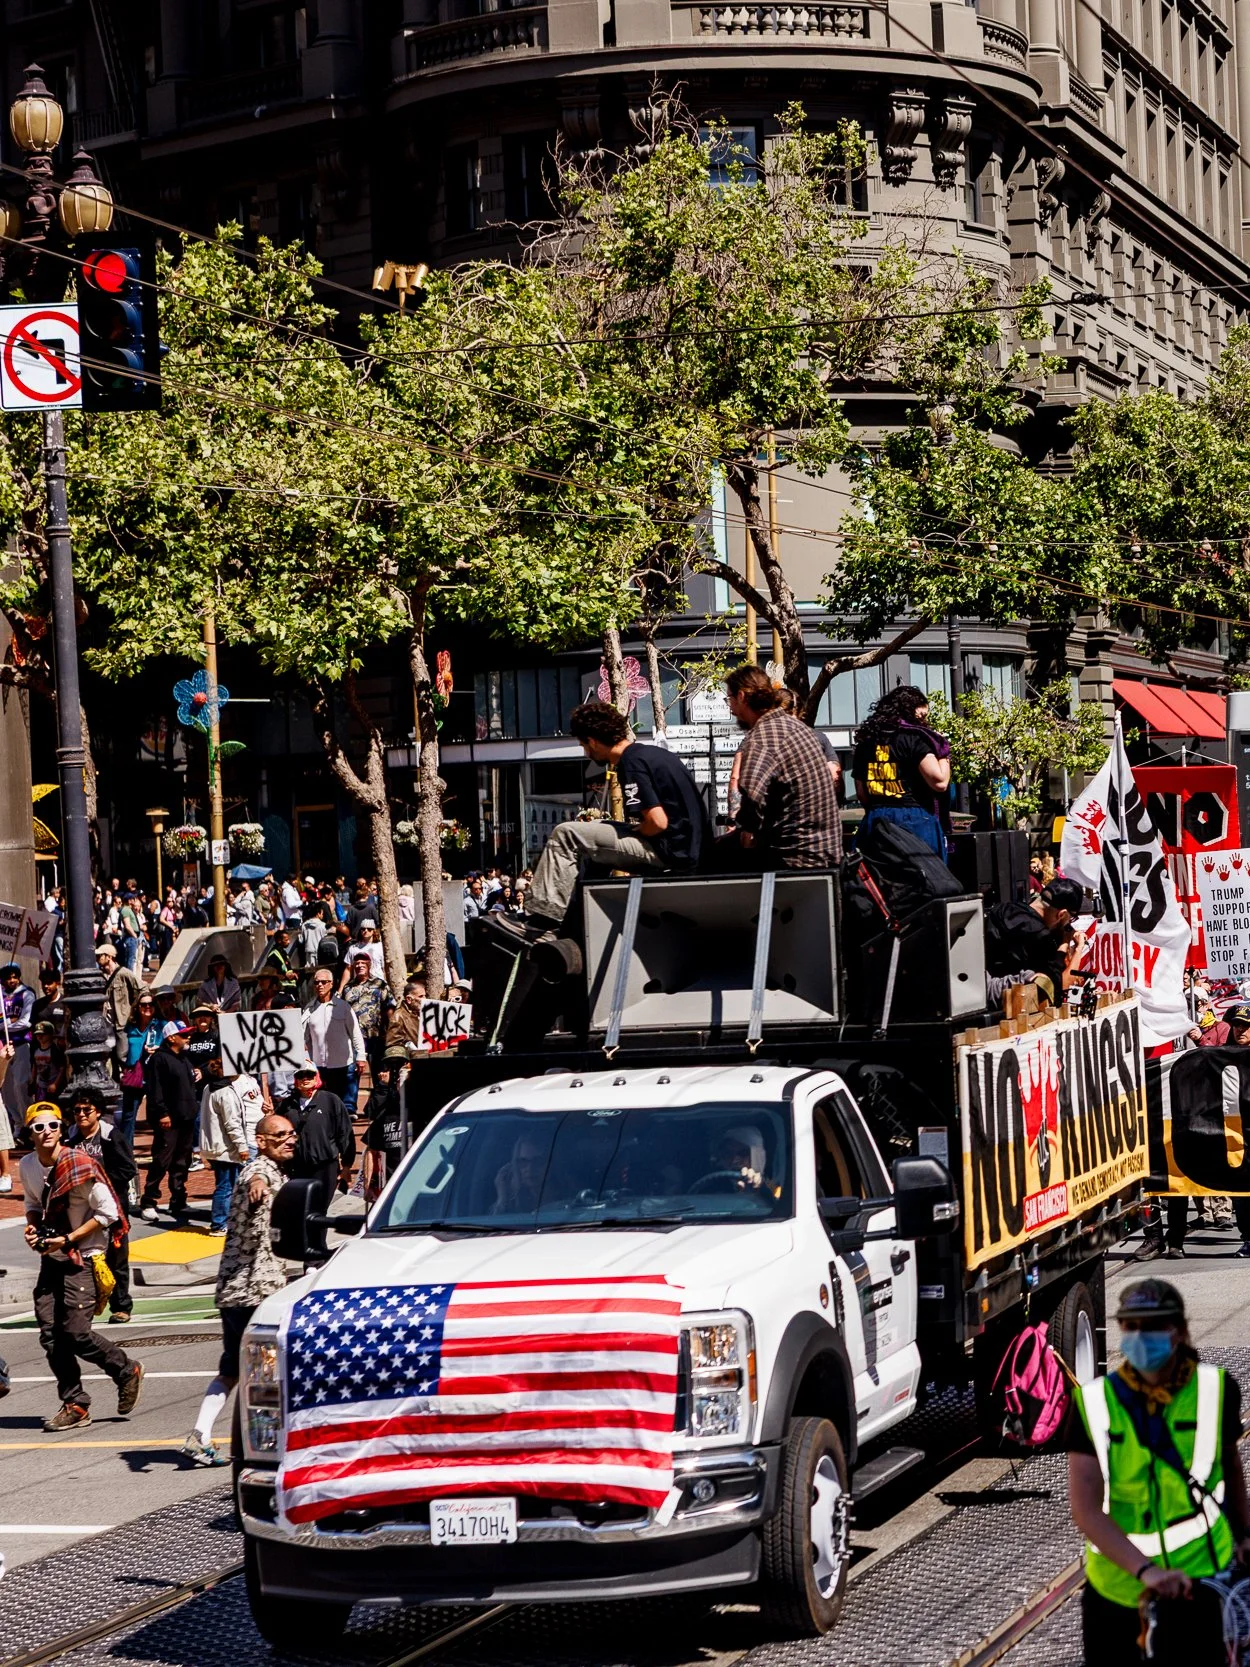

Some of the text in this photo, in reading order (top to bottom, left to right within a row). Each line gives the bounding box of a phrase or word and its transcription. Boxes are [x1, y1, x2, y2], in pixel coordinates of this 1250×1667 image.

[1211, 886, 1244, 901] TRUMP
[1206, 919, 1228, 933] HAVE
[1209, 934, 1239, 948] THEIR
[1210, 949, 1234, 963] STOP
[422, 1002, 468, 1036] FUCK
[222, 1035, 302, 1075] WAR
[967, 1007, 1146, 1254] NO KINGS!
[1025, 1184, 1068, 1230] SAN FRANCISCO
[448, 1503, 497, 1515] California
